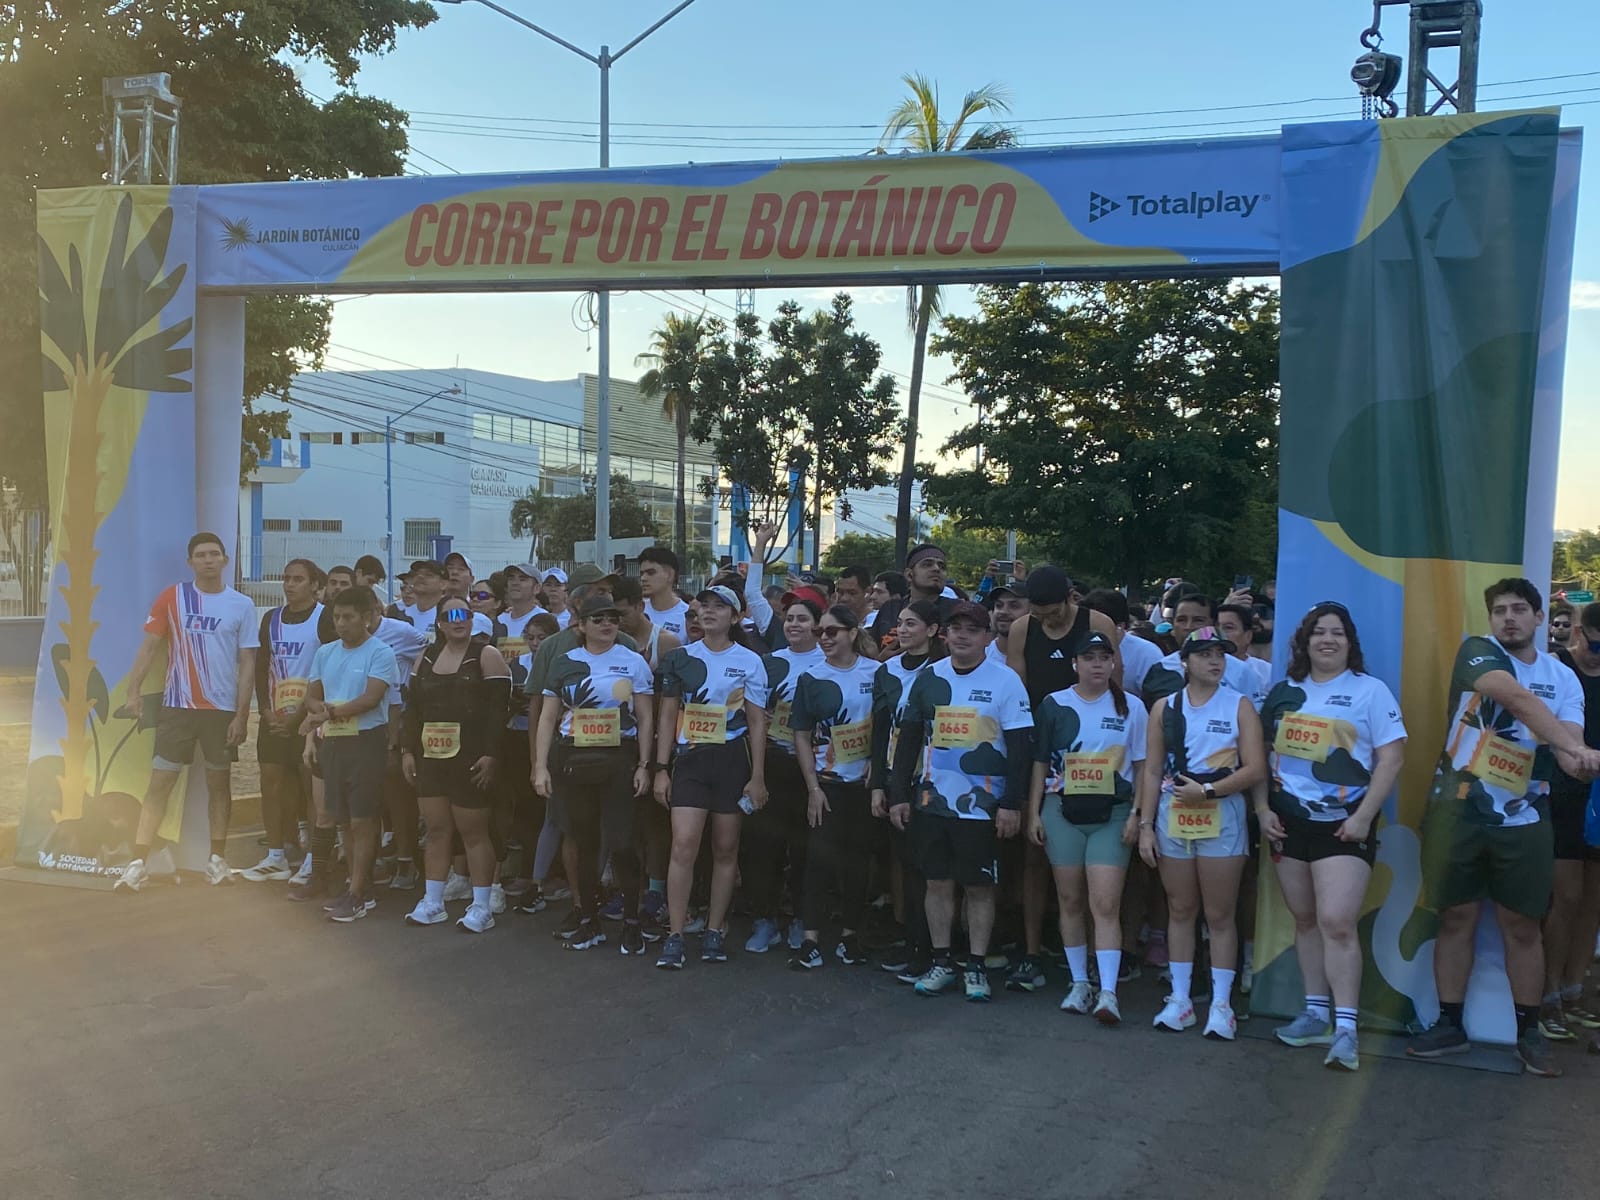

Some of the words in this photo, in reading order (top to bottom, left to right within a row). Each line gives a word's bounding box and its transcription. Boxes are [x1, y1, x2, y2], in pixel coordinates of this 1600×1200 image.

[1127, 190, 1260, 219] Totalplay
[405, 199, 563, 267] CORRE
[562, 196, 670, 264] POR
[672, 193, 729, 262] EL
[739, 174, 1017, 260] BOTÁNICO
[256, 226, 299, 244] JARDÍN
[302, 225, 360, 243] BOTÁNICO
[582, 723, 612, 735] 0002
[689, 720, 718, 732] 0227
[939, 722, 969, 734] 0665
[427, 736, 453, 748] 0210
[1286, 728, 1320, 745] 0093
[1488, 754, 1524, 777] 0094
[1071, 769, 1104, 781] 0540
[1178, 813, 1213, 826] 0664
